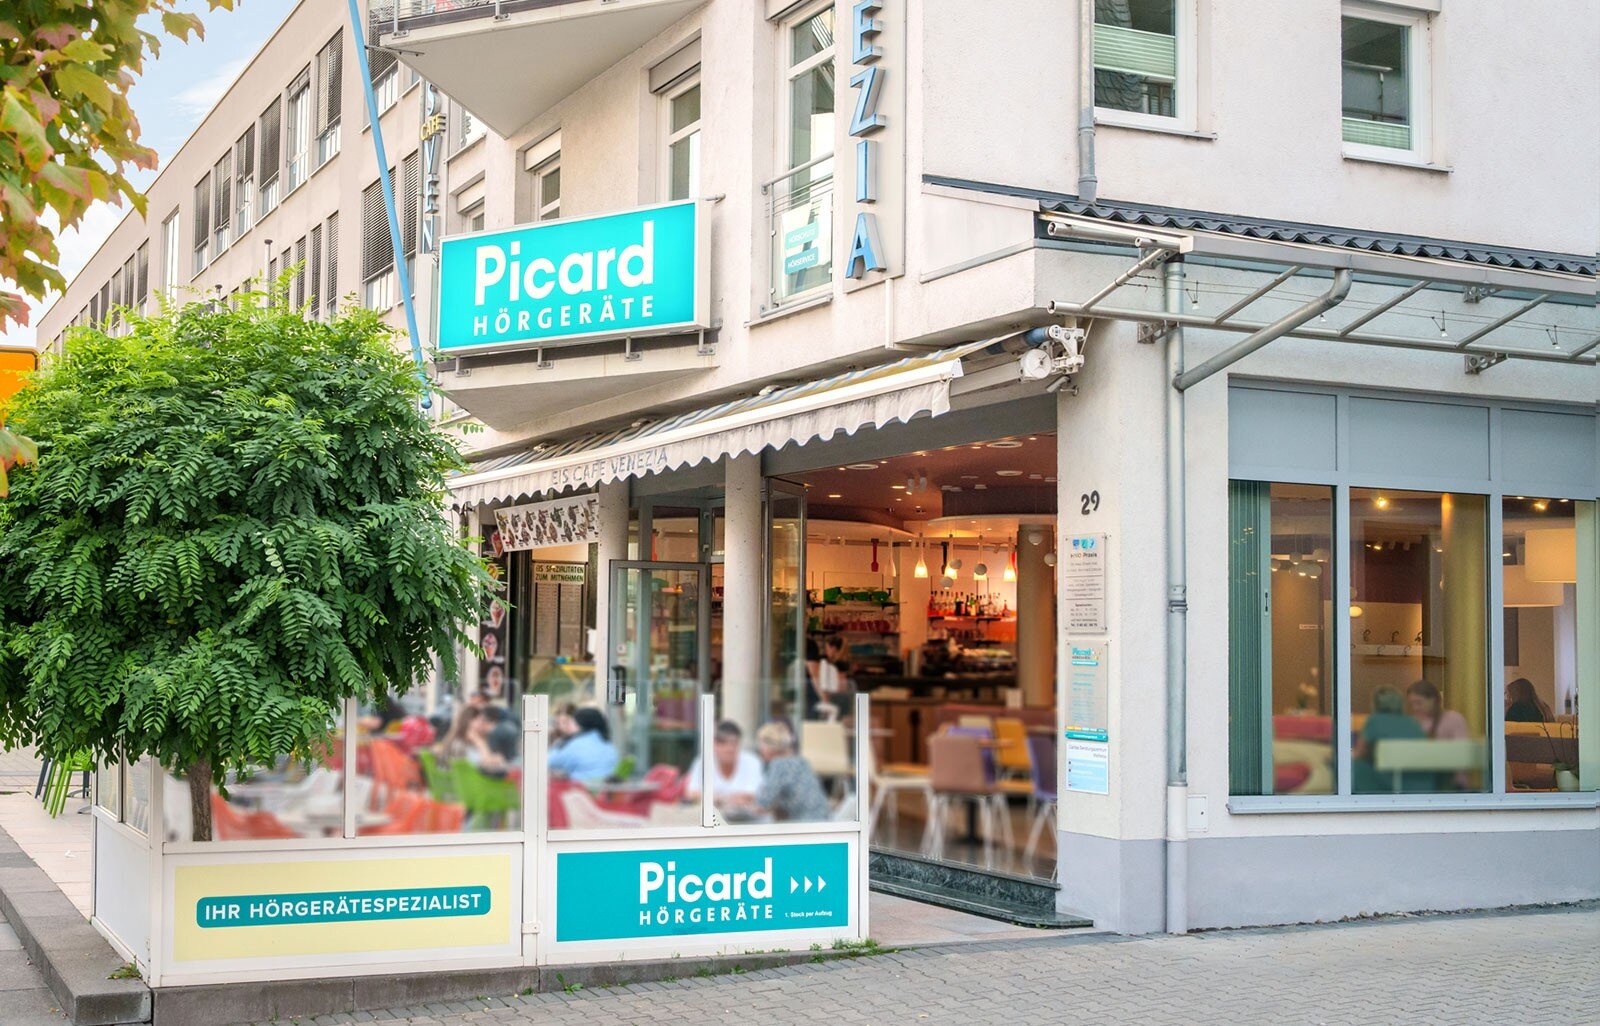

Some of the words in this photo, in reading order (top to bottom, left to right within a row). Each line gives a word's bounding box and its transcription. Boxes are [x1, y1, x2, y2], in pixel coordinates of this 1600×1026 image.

[845, 0, 886, 280] EZIA
[474, 220, 654, 306] Picard
[473, 294, 653, 337] HÖRGERÄTE
[551, 468, 569, 485] EIS
[610, 447, 668, 474] VENEZIA
[1081, 490, 1100, 516] 29
[639, 857, 773, 904] Picard
[205, 904, 241, 921] IHR
[249, 893, 482, 919] HÖRGERÄTESPEZIALIST
[639, 902, 773, 926] HÖRGERÄTE
